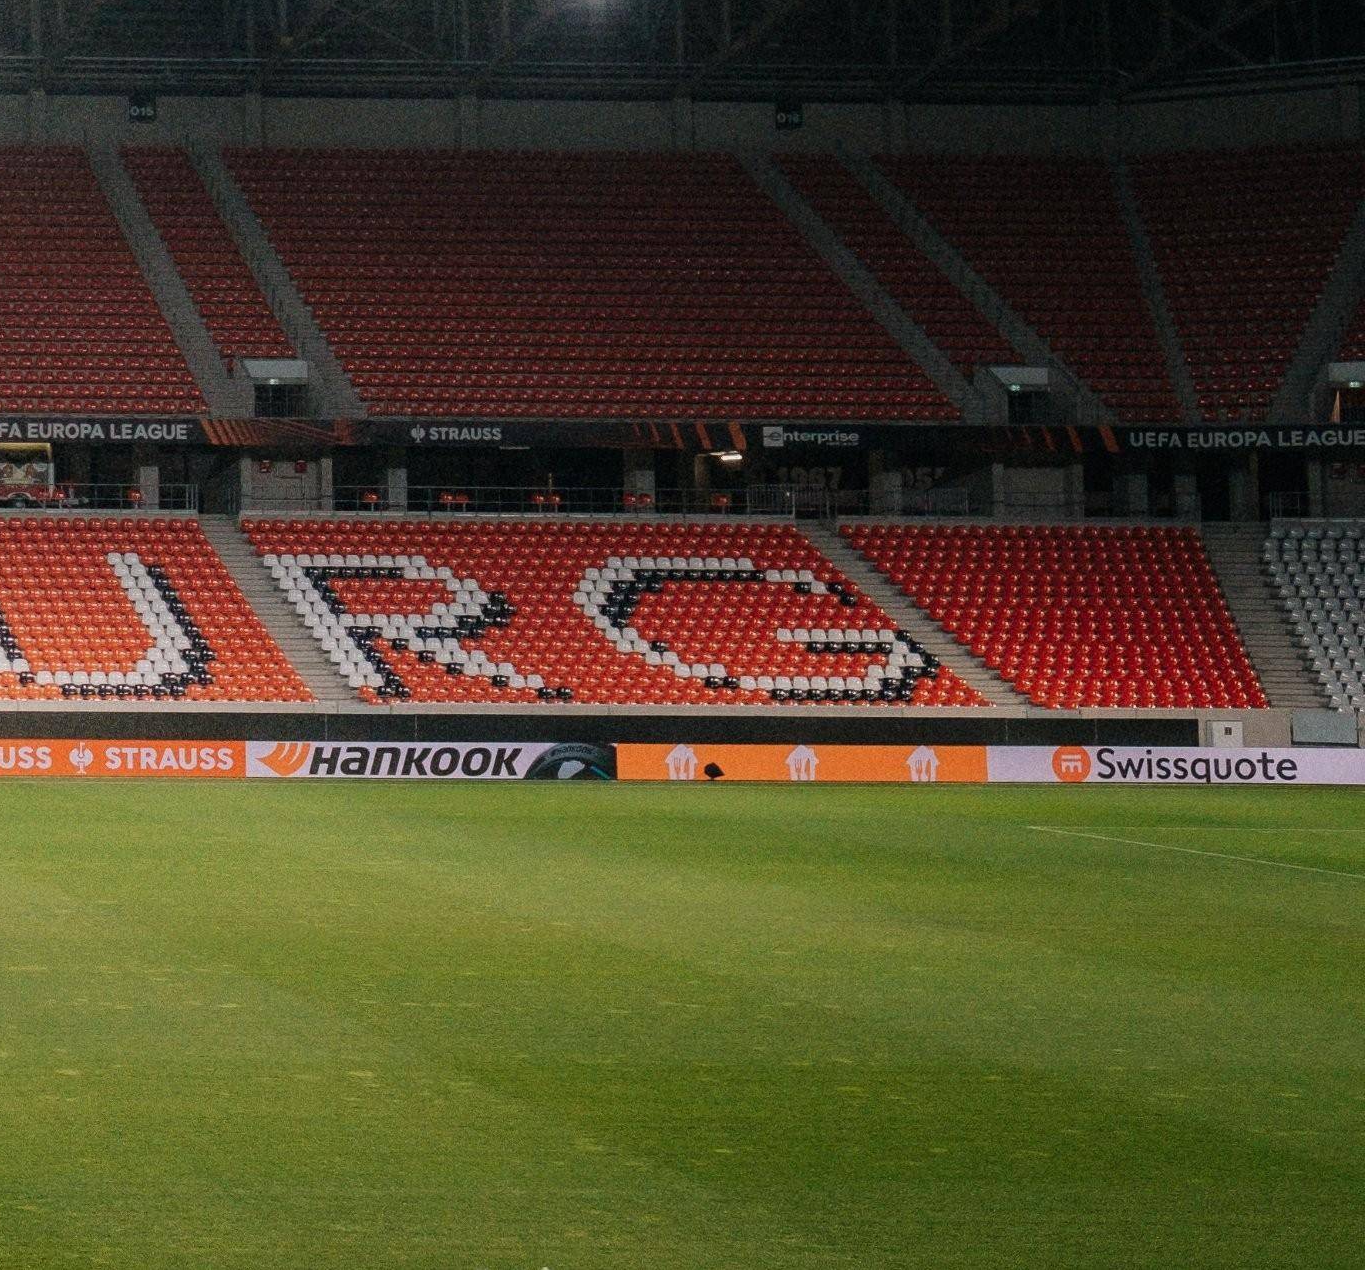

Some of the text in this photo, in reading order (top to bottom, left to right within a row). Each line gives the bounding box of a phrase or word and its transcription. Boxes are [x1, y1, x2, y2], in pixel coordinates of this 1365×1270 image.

[27, 423, 105, 439] EUROPA
[110, 424, 188, 440] LEAGUE
[429, 426, 502, 441] STRAUSS
[768, 430, 860, 444] enterprise
[1129, 429, 1365, 448] UEFA EUROPA LEAGUE
[104, 747, 234, 771] STRAUSS
[1096, 748, 1298, 783] Swissquote
